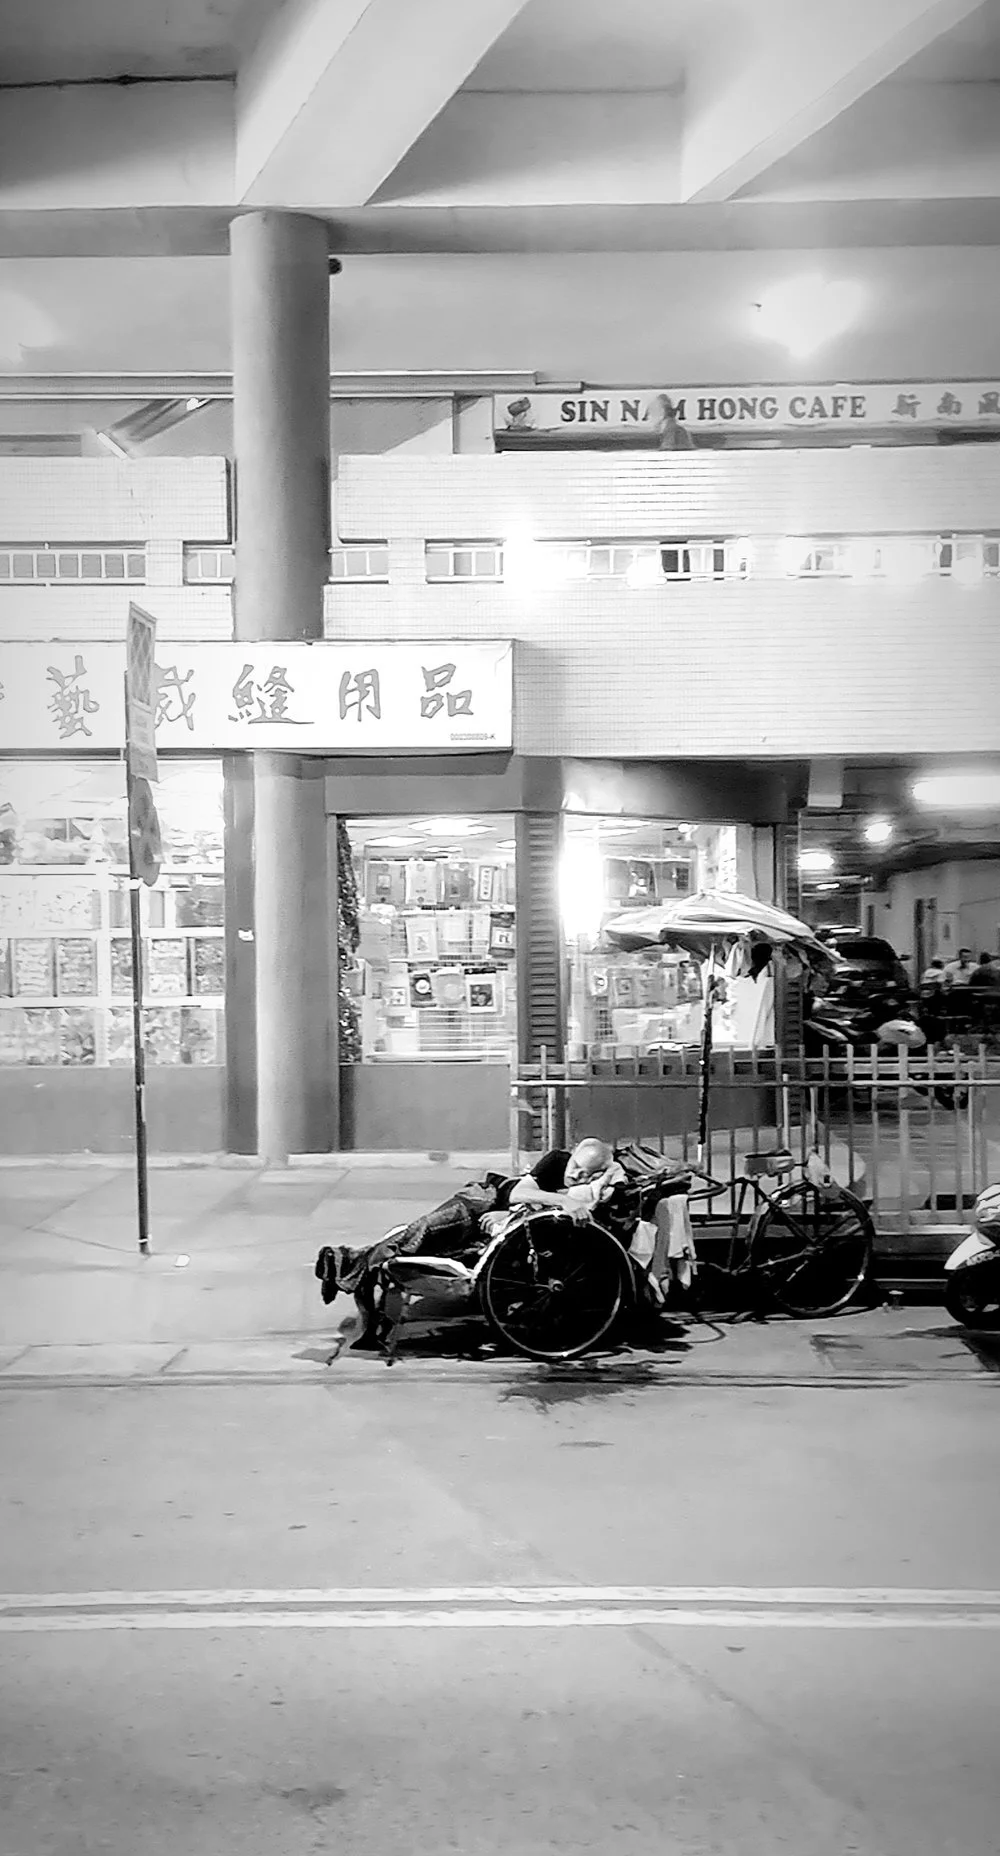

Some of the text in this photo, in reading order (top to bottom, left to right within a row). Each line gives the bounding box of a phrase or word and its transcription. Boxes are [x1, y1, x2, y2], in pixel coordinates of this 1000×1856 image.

[560, 395, 866, 423] SIN NM HONG CAFE
